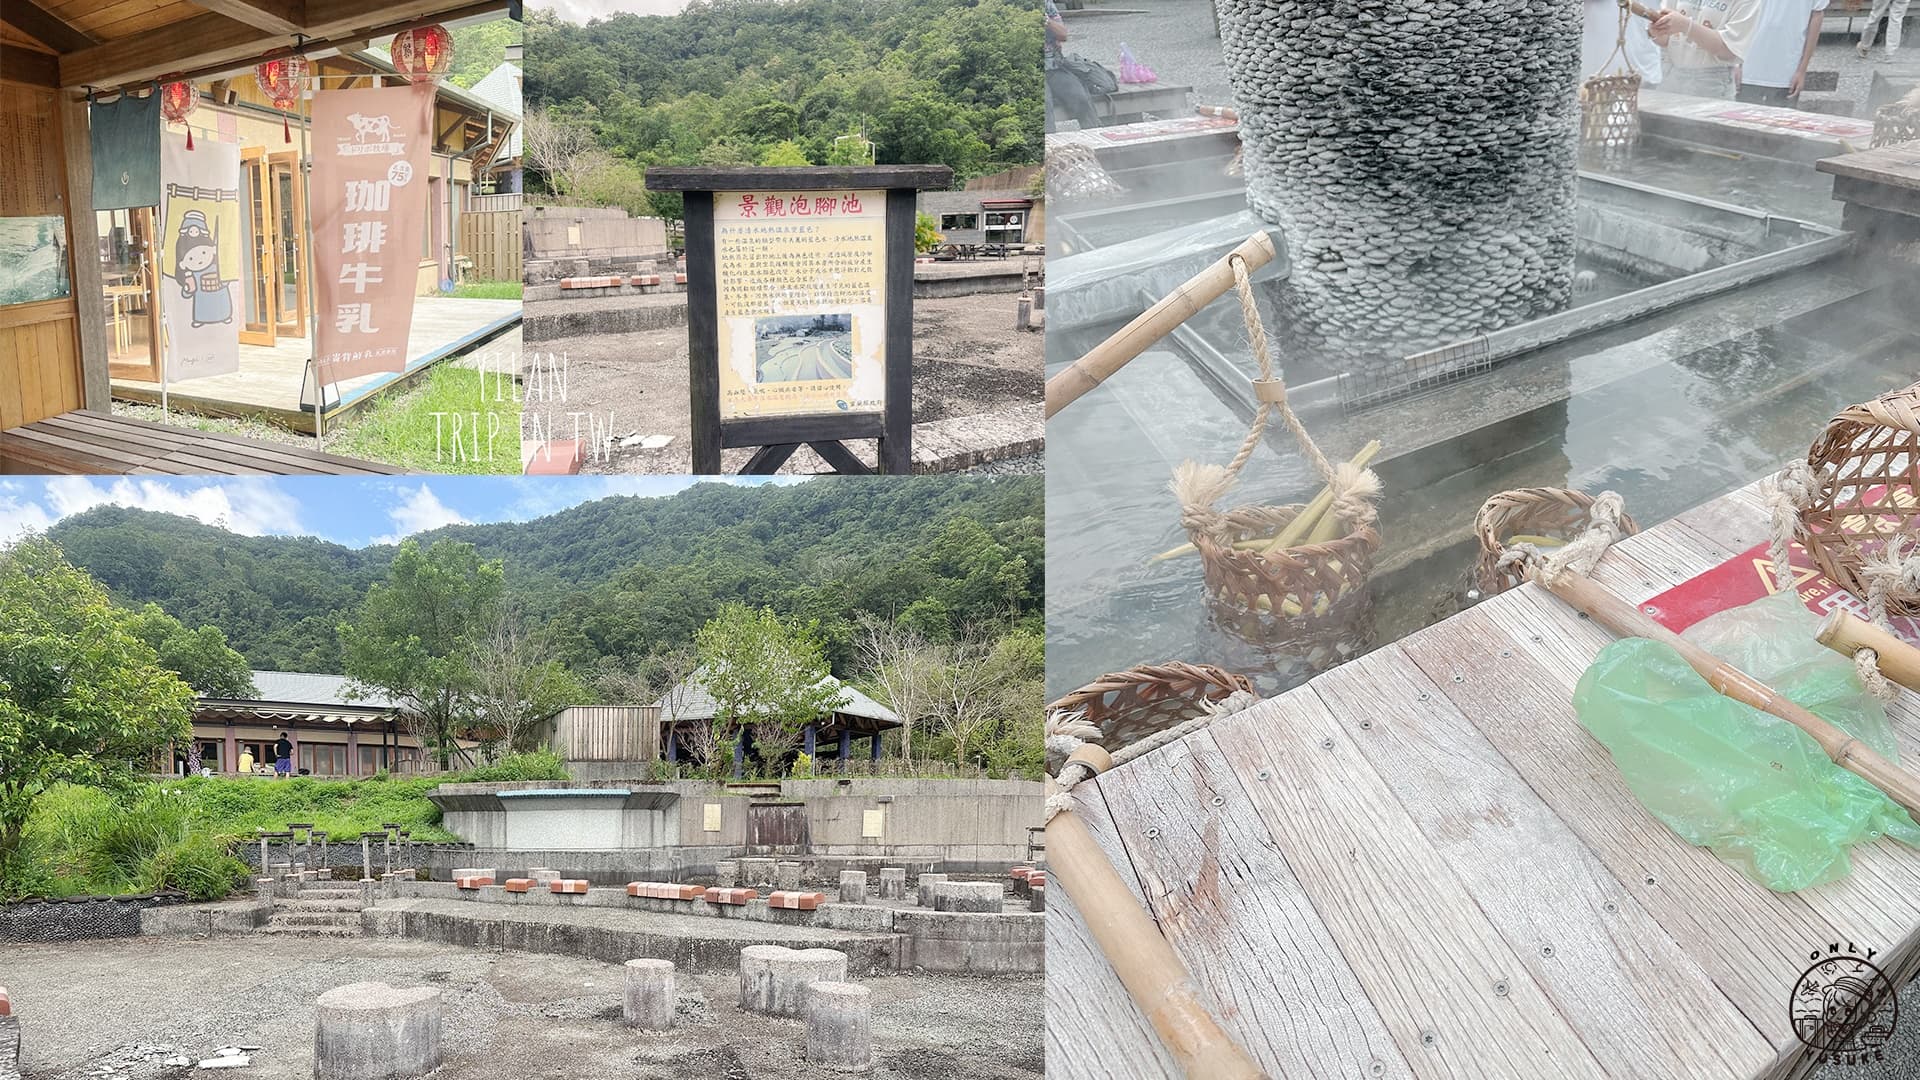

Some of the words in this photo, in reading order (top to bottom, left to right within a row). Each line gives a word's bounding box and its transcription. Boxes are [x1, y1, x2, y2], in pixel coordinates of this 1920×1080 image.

[737, 192, 863, 218] 景觀泡腳池
[335, 179, 391, 334] 珈琲牛乳
